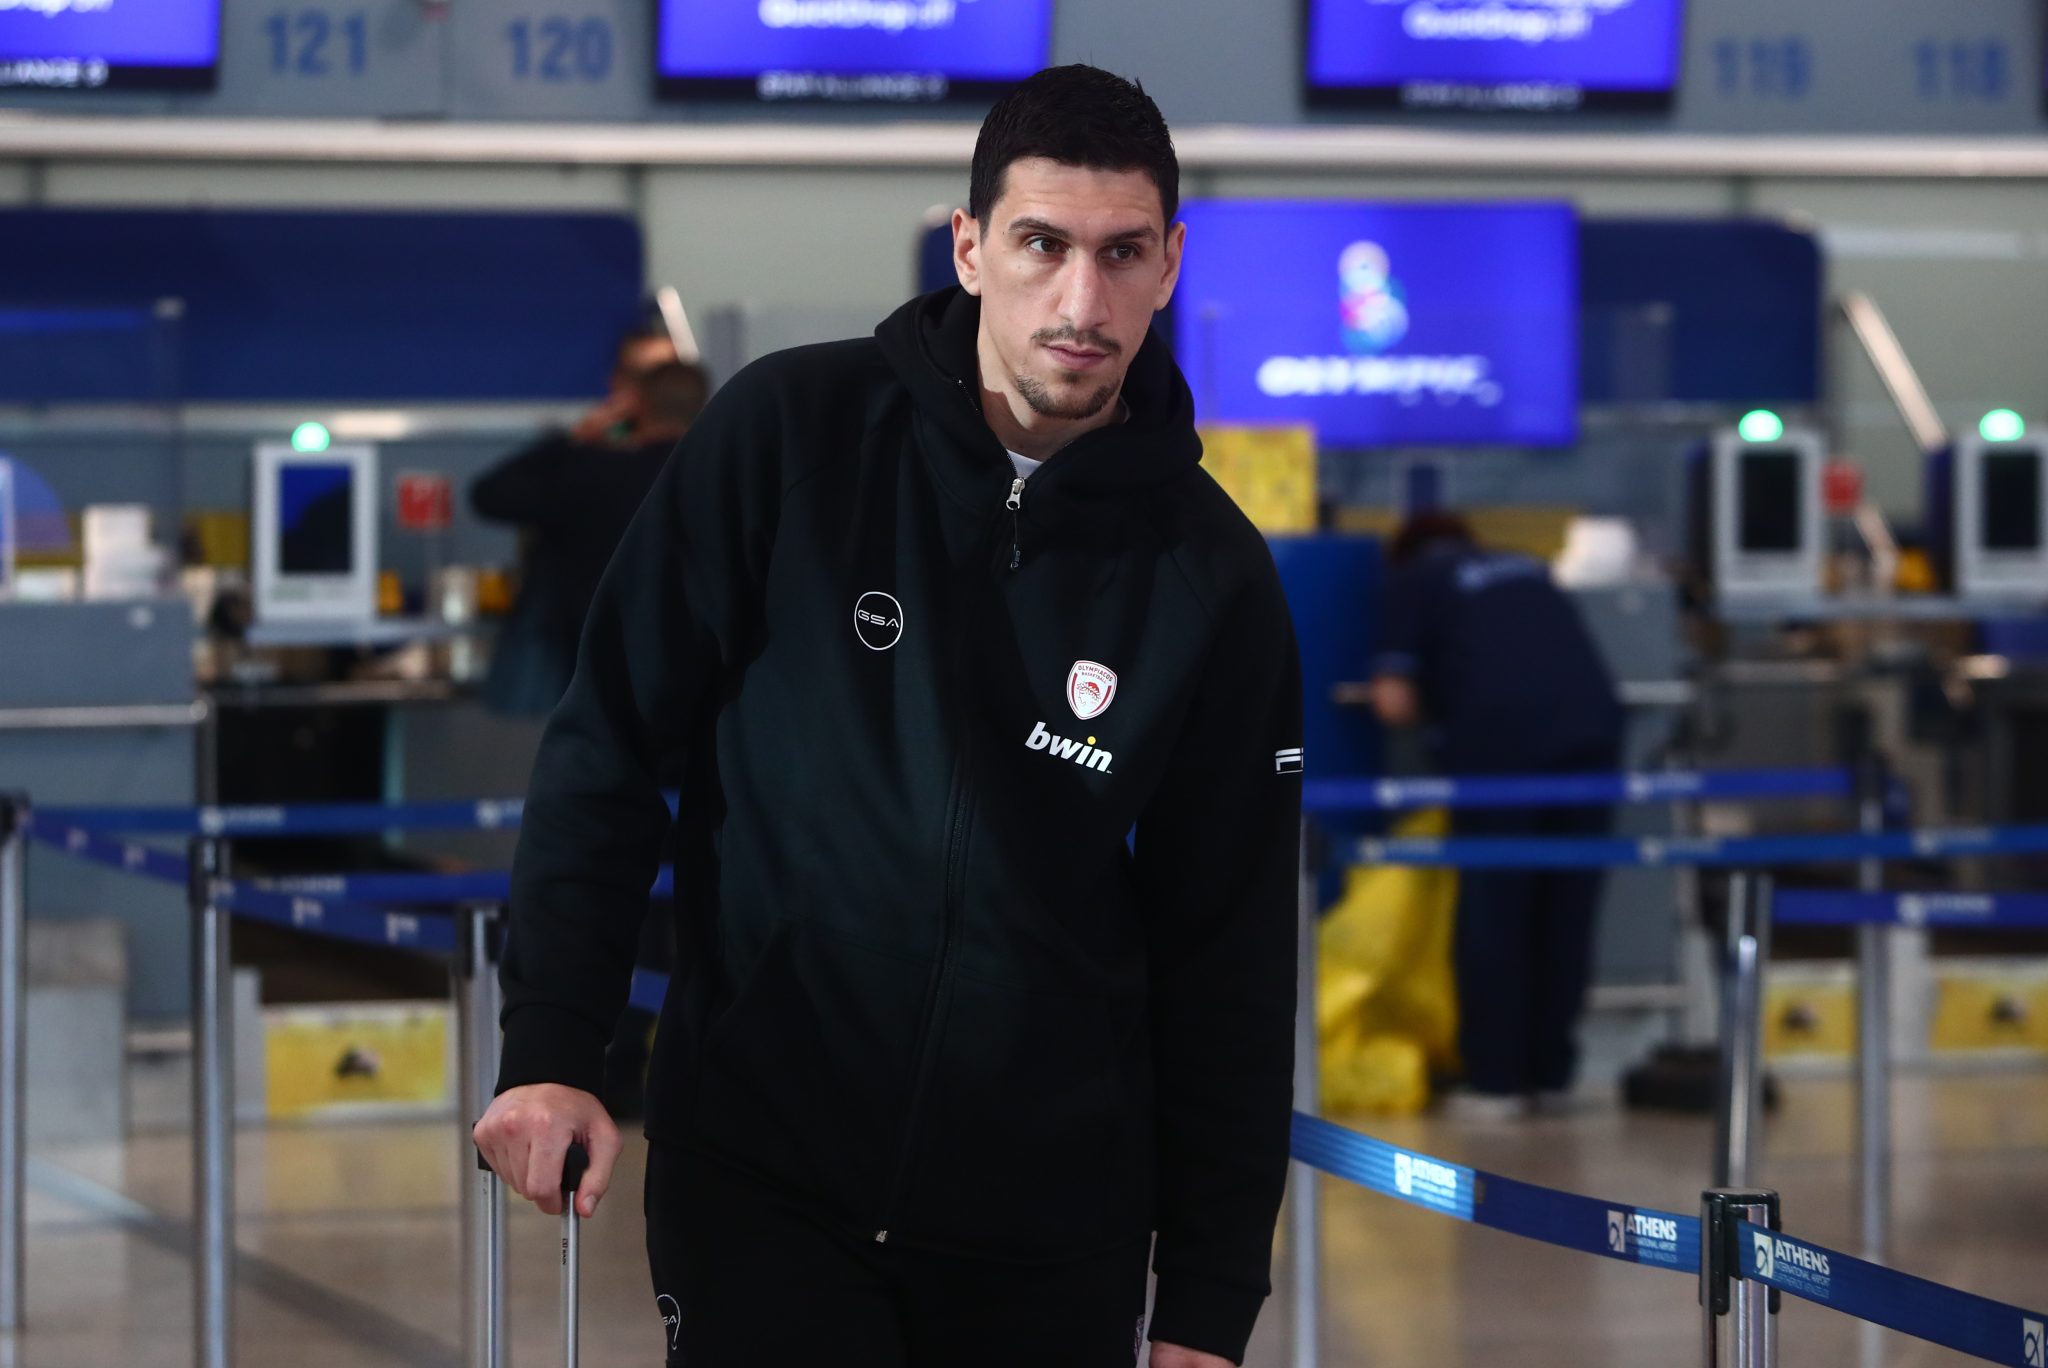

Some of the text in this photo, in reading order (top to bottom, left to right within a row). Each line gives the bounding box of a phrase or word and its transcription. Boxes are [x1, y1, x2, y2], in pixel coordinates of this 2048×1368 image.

[266, 11, 367, 76] 121
[508, 17, 613, 83] 120
[858, 609, 899, 628] GSA
[1078, 664, 1114, 682] OLYMPIACOS
[1025, 721, 1113, 773] bwin
[1625, 1213, 1678, 1242] ATHENS
[1774, 1239, 1831, 1275] ATHENS
